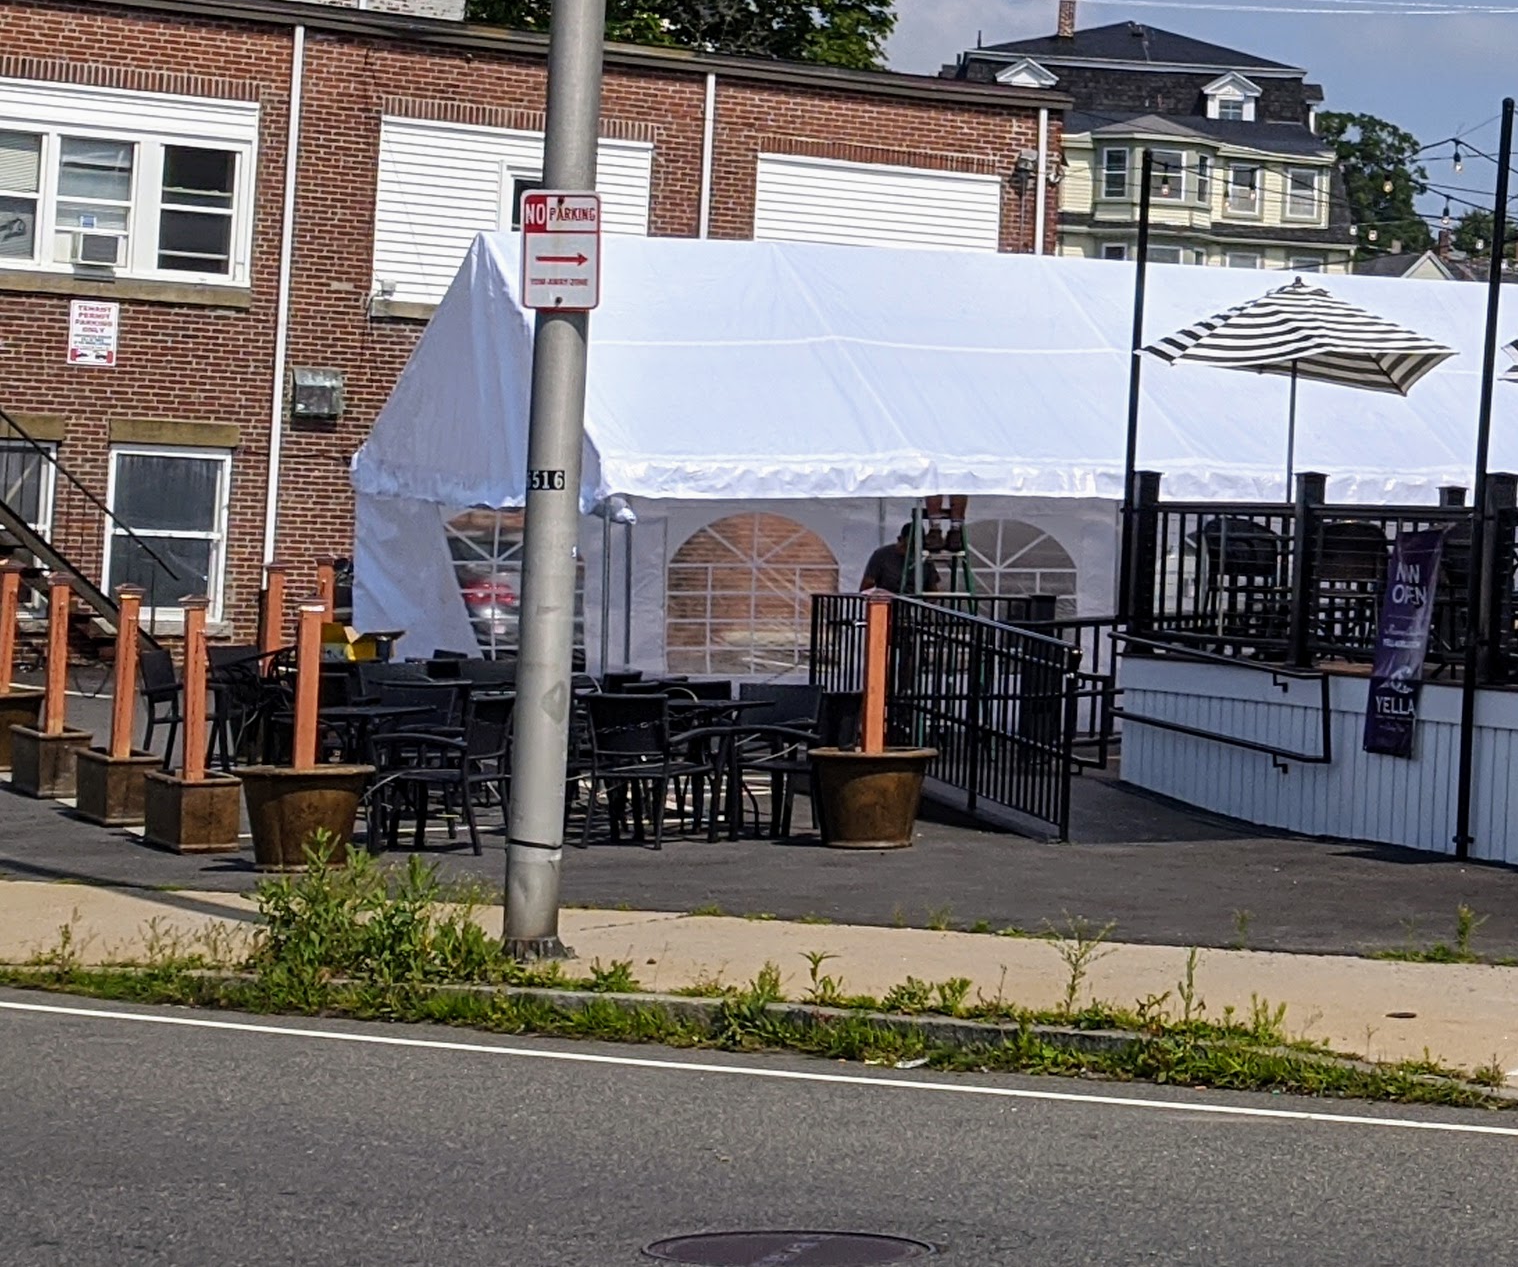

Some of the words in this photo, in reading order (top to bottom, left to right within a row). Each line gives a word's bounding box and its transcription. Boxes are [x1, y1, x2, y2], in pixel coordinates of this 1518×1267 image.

[525, 203, 546, 224] NO
[549, 207, 596, 221] PARKING
[1375, 695, 1415, 715] YELLA
